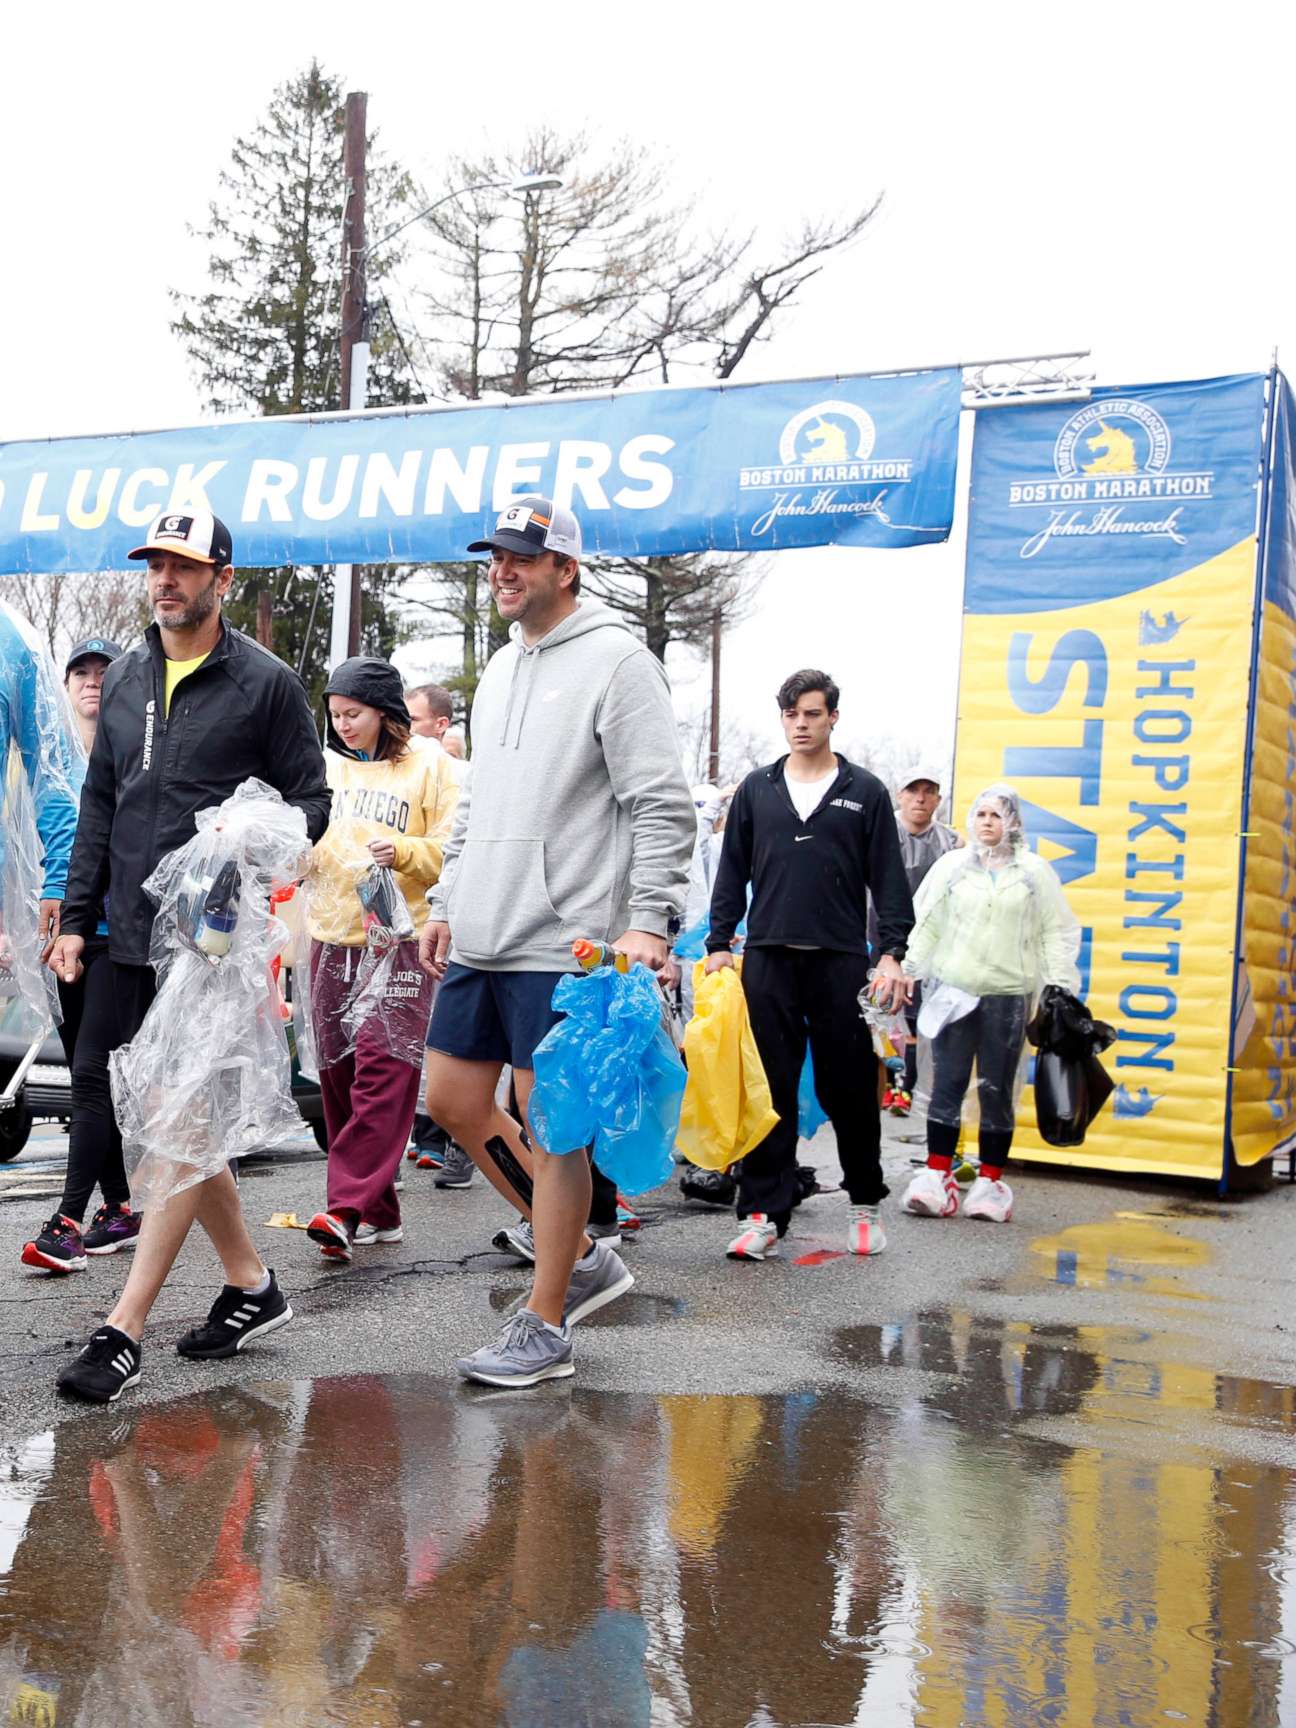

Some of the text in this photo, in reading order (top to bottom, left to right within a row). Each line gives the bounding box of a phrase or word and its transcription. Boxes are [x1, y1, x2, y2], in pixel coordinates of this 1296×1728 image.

[1059, 402, 1166, 474] BOSTON ATHLETIC ASSOCIATION
[21, 460, 228, 532] LUCK
[241, 434, 676, 523] RUNNERS
[740, 462, 910, 486] BOSTON MARATHON
[1010, 475, 1212, 504] BOSTON MARATHON
[751, 488, 891, 537] John Hancock
[1020, 506, 1188, 559] John Hancock
[142, 714, 155, 771] ENDURANCE
[351, 788, 410, 834] DIEGO
[1004, 629, 1108, 1084] STA
[1115, 659, 1196, 1072] HOPKINTON
[384, 986, 420, 998] LLEGIATE
